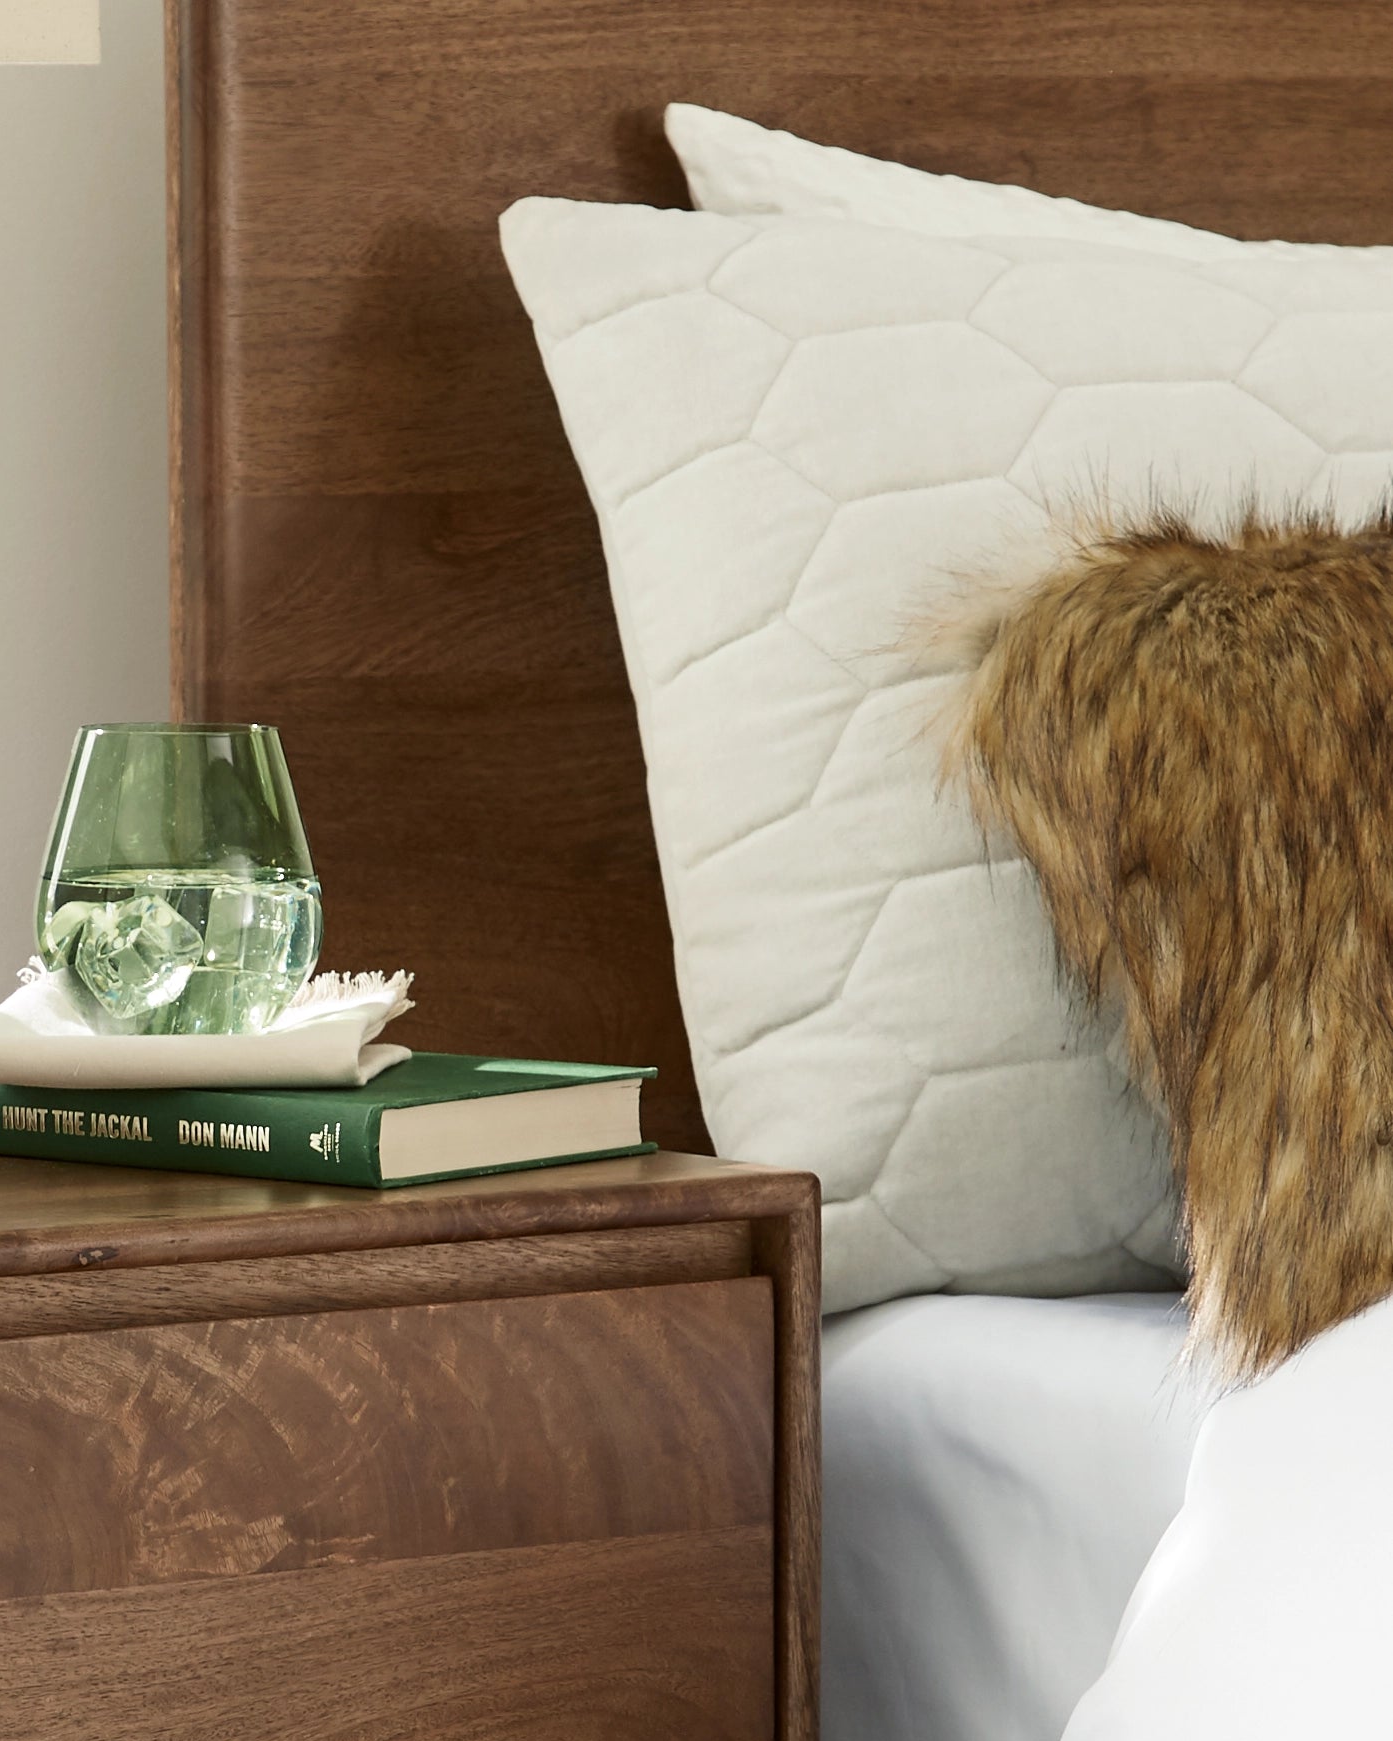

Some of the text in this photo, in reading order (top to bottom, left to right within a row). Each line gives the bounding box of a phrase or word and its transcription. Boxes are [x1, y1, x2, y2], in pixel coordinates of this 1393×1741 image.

[2, 1105, 48, 1133] HUNT
[52, 1109, 86, 1136] THE
[90, 1112, 152, 1142] JACKAL
[178, 1119, 215, 1147] DON
[220, 1123, 270, 1152] MANN
